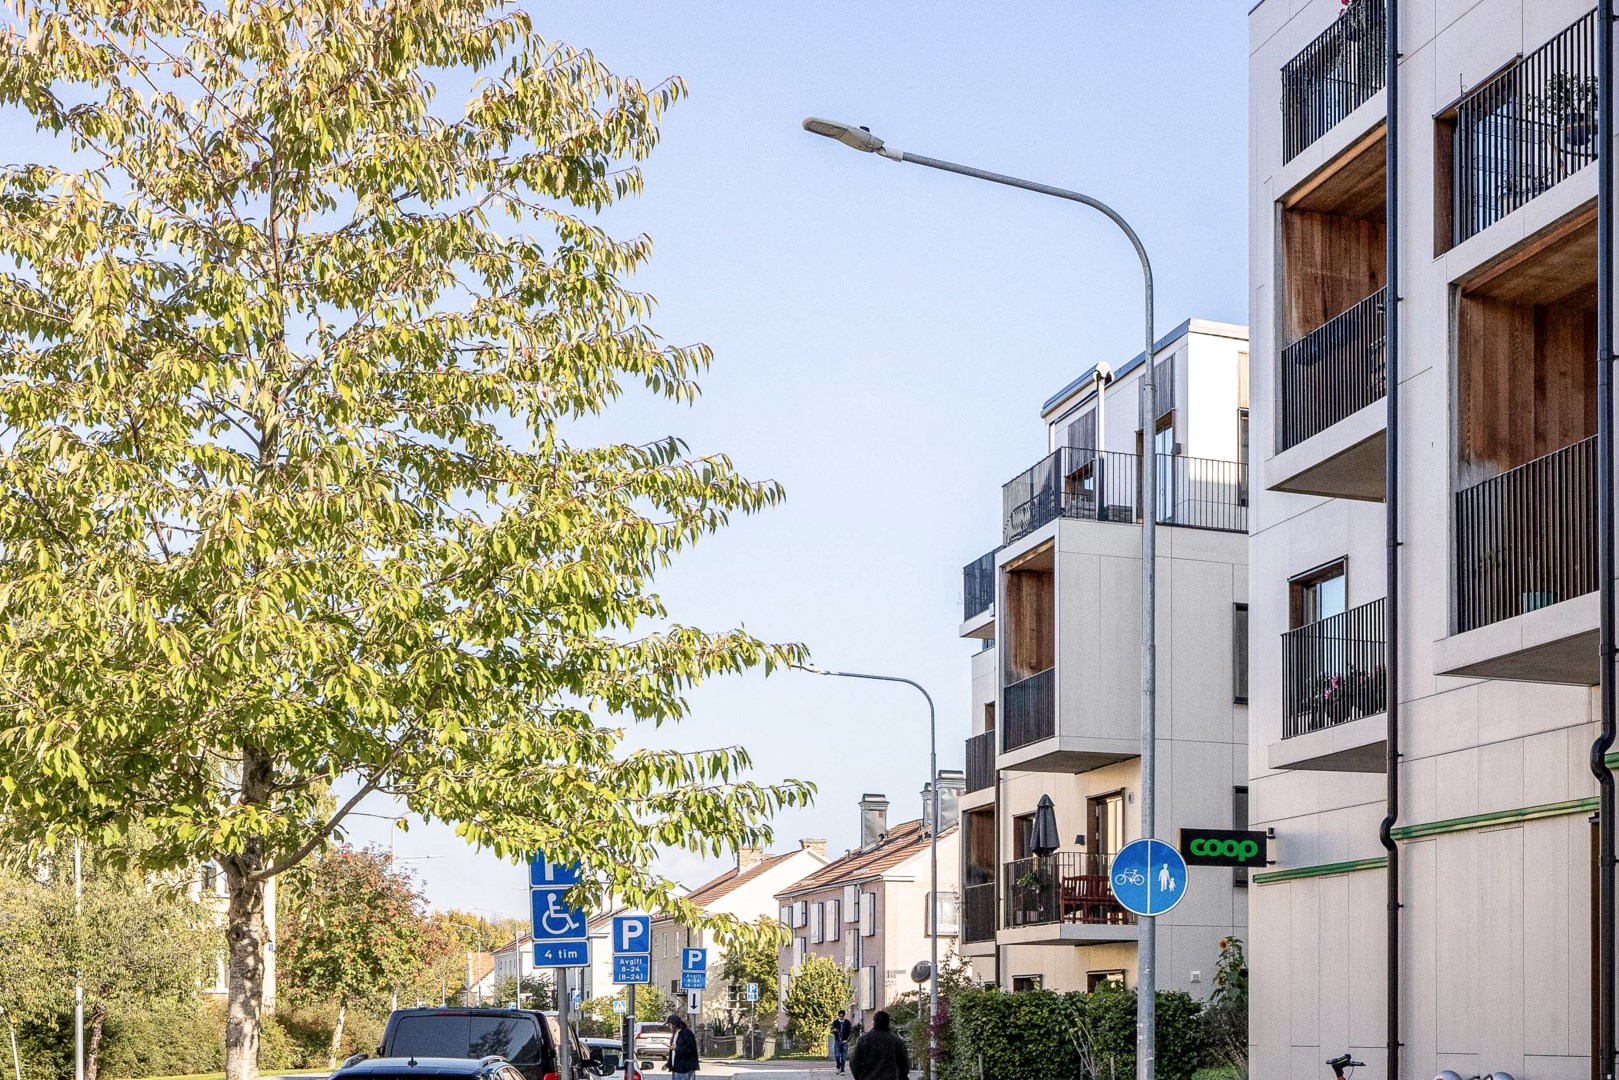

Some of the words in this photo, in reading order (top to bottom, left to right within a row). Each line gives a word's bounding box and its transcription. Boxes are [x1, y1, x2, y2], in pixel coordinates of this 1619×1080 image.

[1190, 838, 1258, 862] coop
[622, 919, 643, 950] P
[544, 950, 552, 959] 4
[558, 949, 577, 958] tim
[619, 958, 642, 966] Avgift
[688, 950, 702, 969] P
